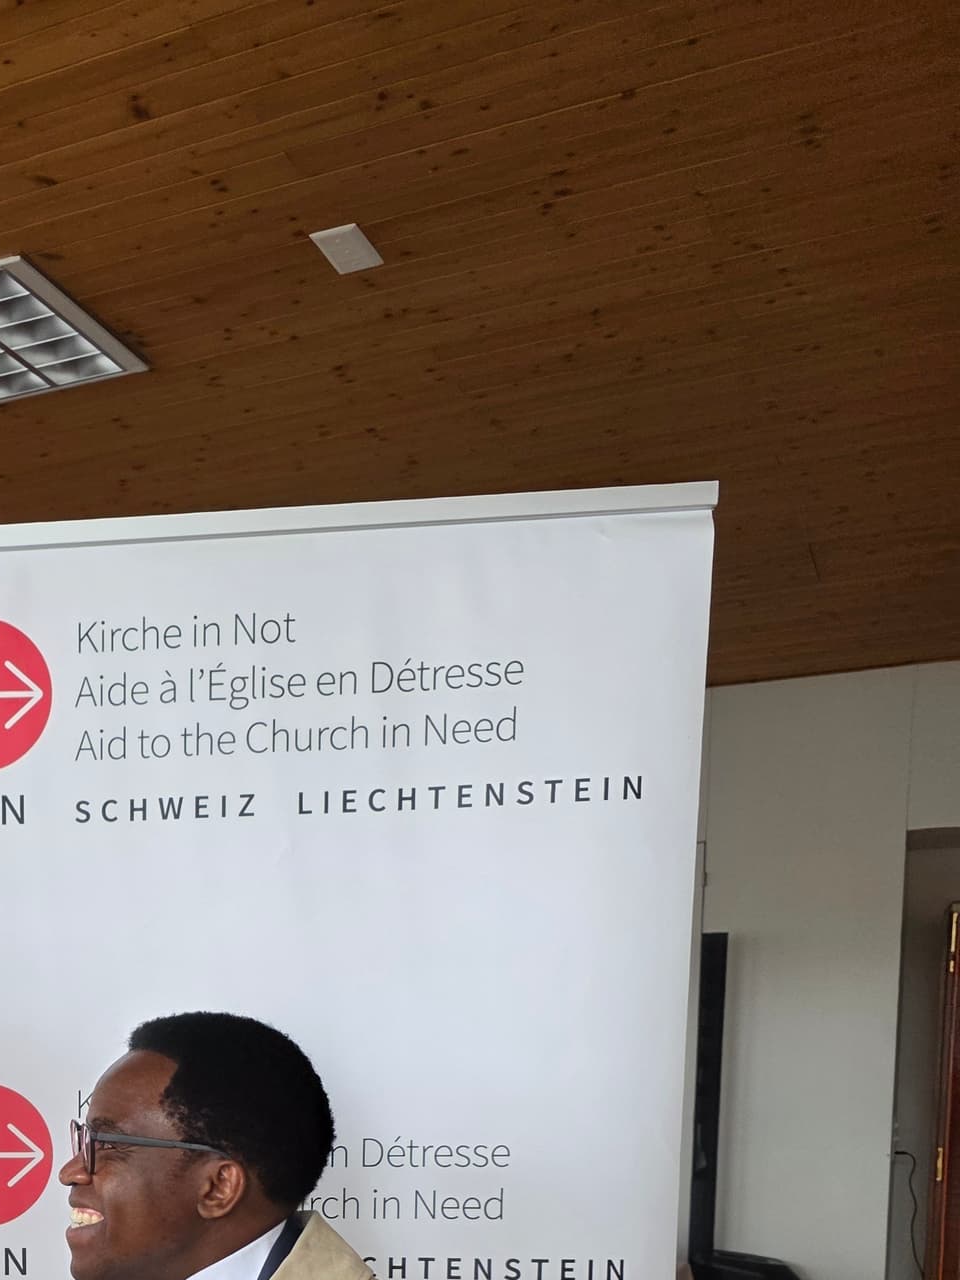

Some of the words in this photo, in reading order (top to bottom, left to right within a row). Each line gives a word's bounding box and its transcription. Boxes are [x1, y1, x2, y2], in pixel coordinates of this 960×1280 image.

[76, 616, 181, 654] Kirche
[193, 615, 220, 650] in
[235, 612, 296, 646] Not
[75, 672, 150, 708] Aide
[159, 669, 177, 705] à
[189, 662, 307, 711] l’Église
[316, 671, 358, 696] en
[371, 657, 525, 694] Détresse
[75, 726, 127, 761] Aid
[138, 729, 171, 760] to
[181, 721, 237, 757] the
[245, 716, 369, 755] Church
[382, 715, 411, 749] in
[424, 706, 517, 747] Need
[74, 793, 256, 824] SCHWEIZ
[297, 775, 643, 816] LIECHTENSTEIN
[330, 1145, 349, 1168] n
[361, 1135, 511, 1168] Détresse
[302, 1187, 360, 1220] rch
[372, 1188, 401, 1220] in
[414, 1188, 504, 1221] Need
